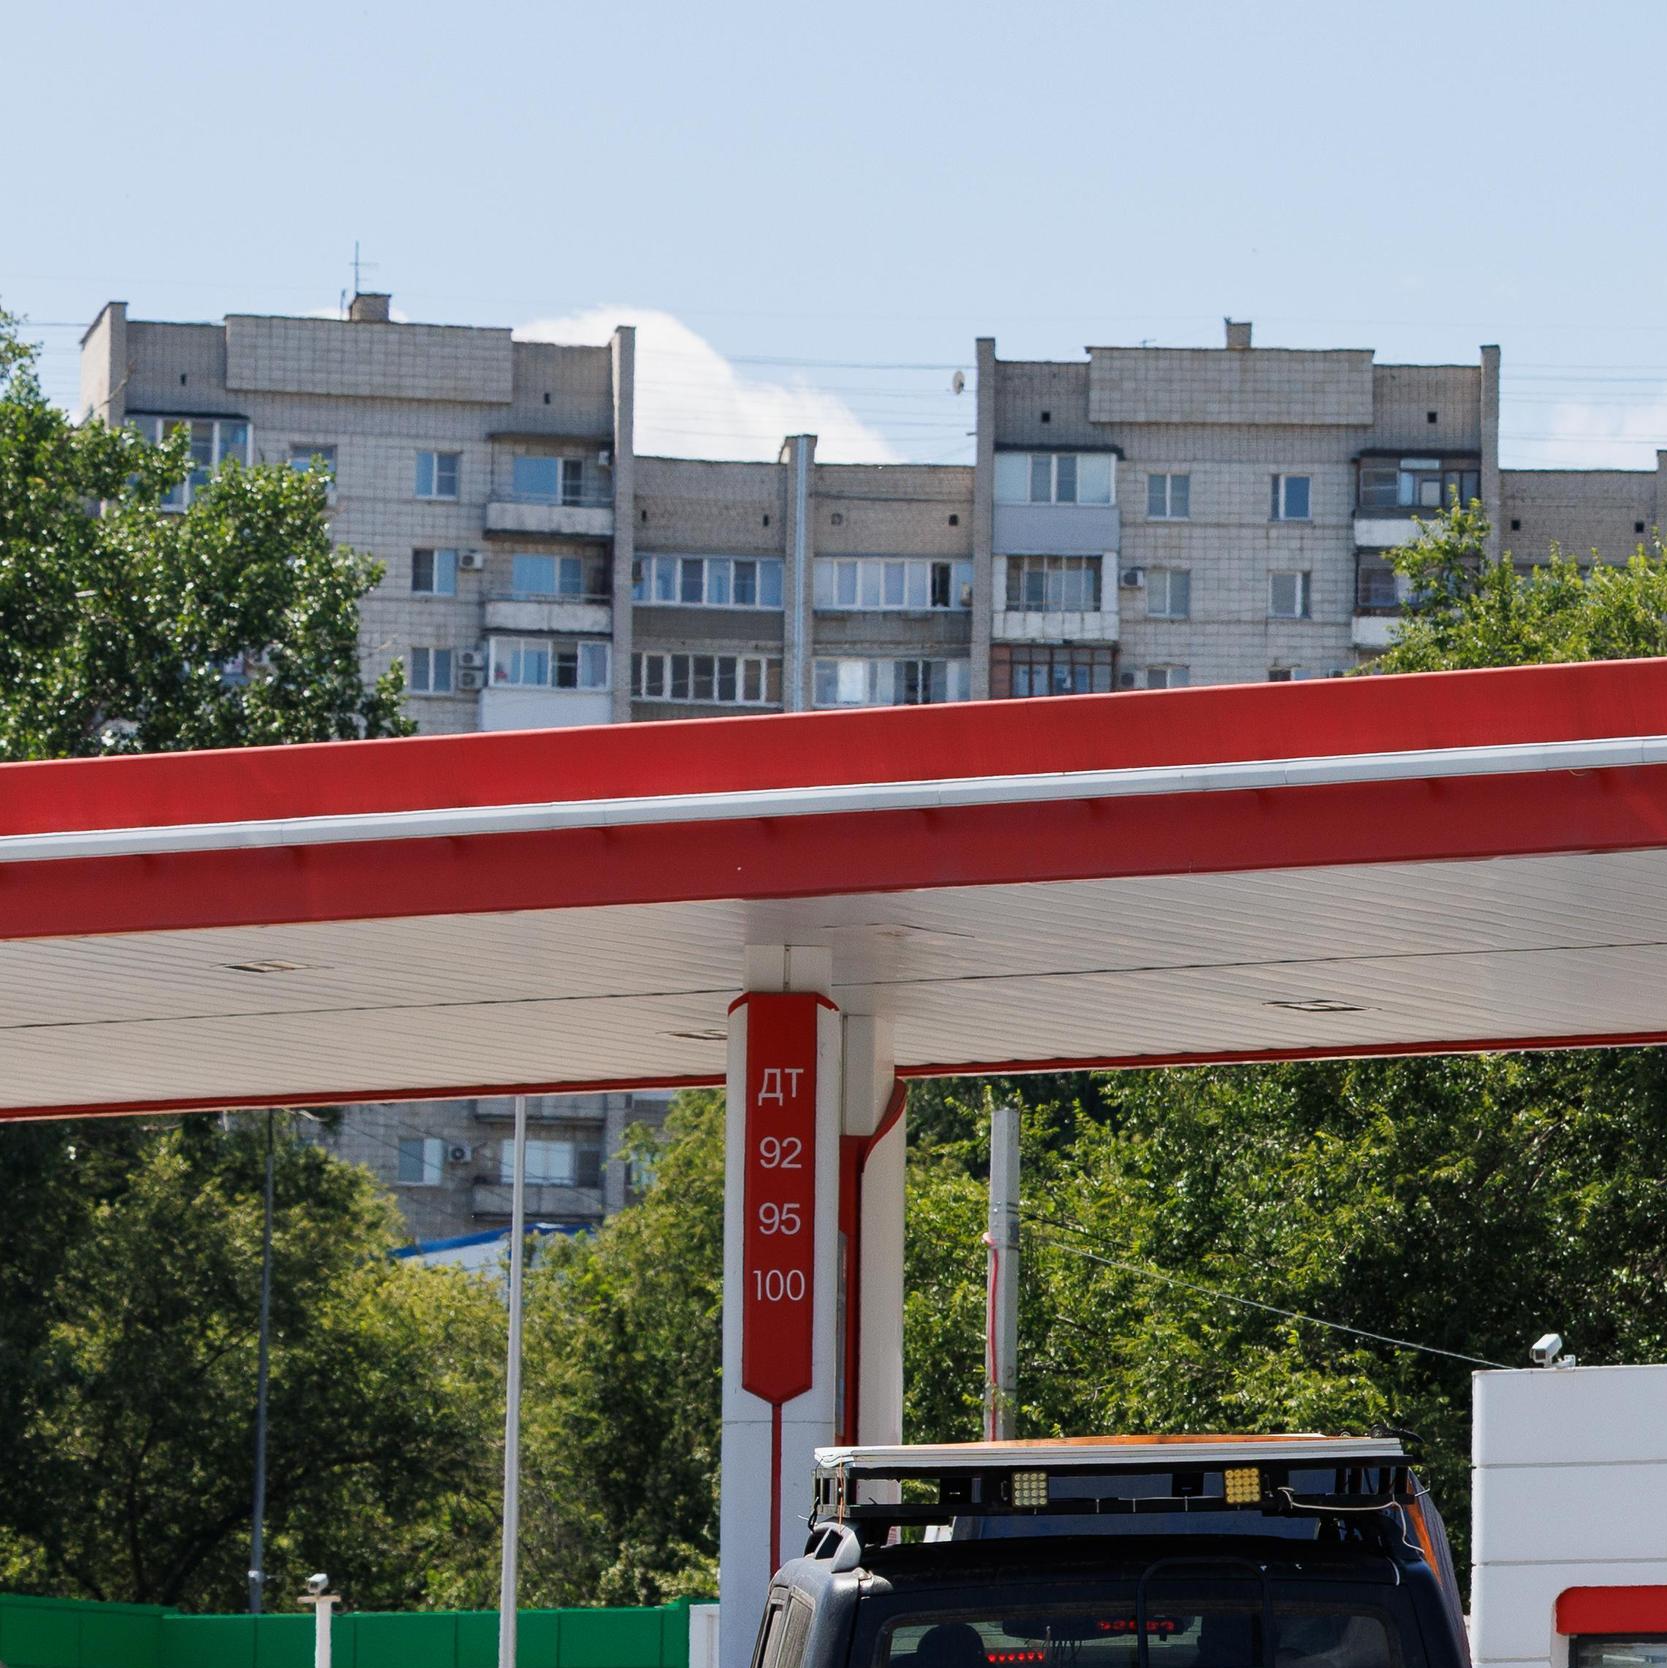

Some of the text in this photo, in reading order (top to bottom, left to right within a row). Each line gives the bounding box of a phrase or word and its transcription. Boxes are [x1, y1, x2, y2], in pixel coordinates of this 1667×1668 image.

[757, 1068, 804, 1106] ДТ
[759, 1136, 802, 1169] 92
[758, 1202, 801, 1236] 95
[752, 1269, 806, 1302] 100
